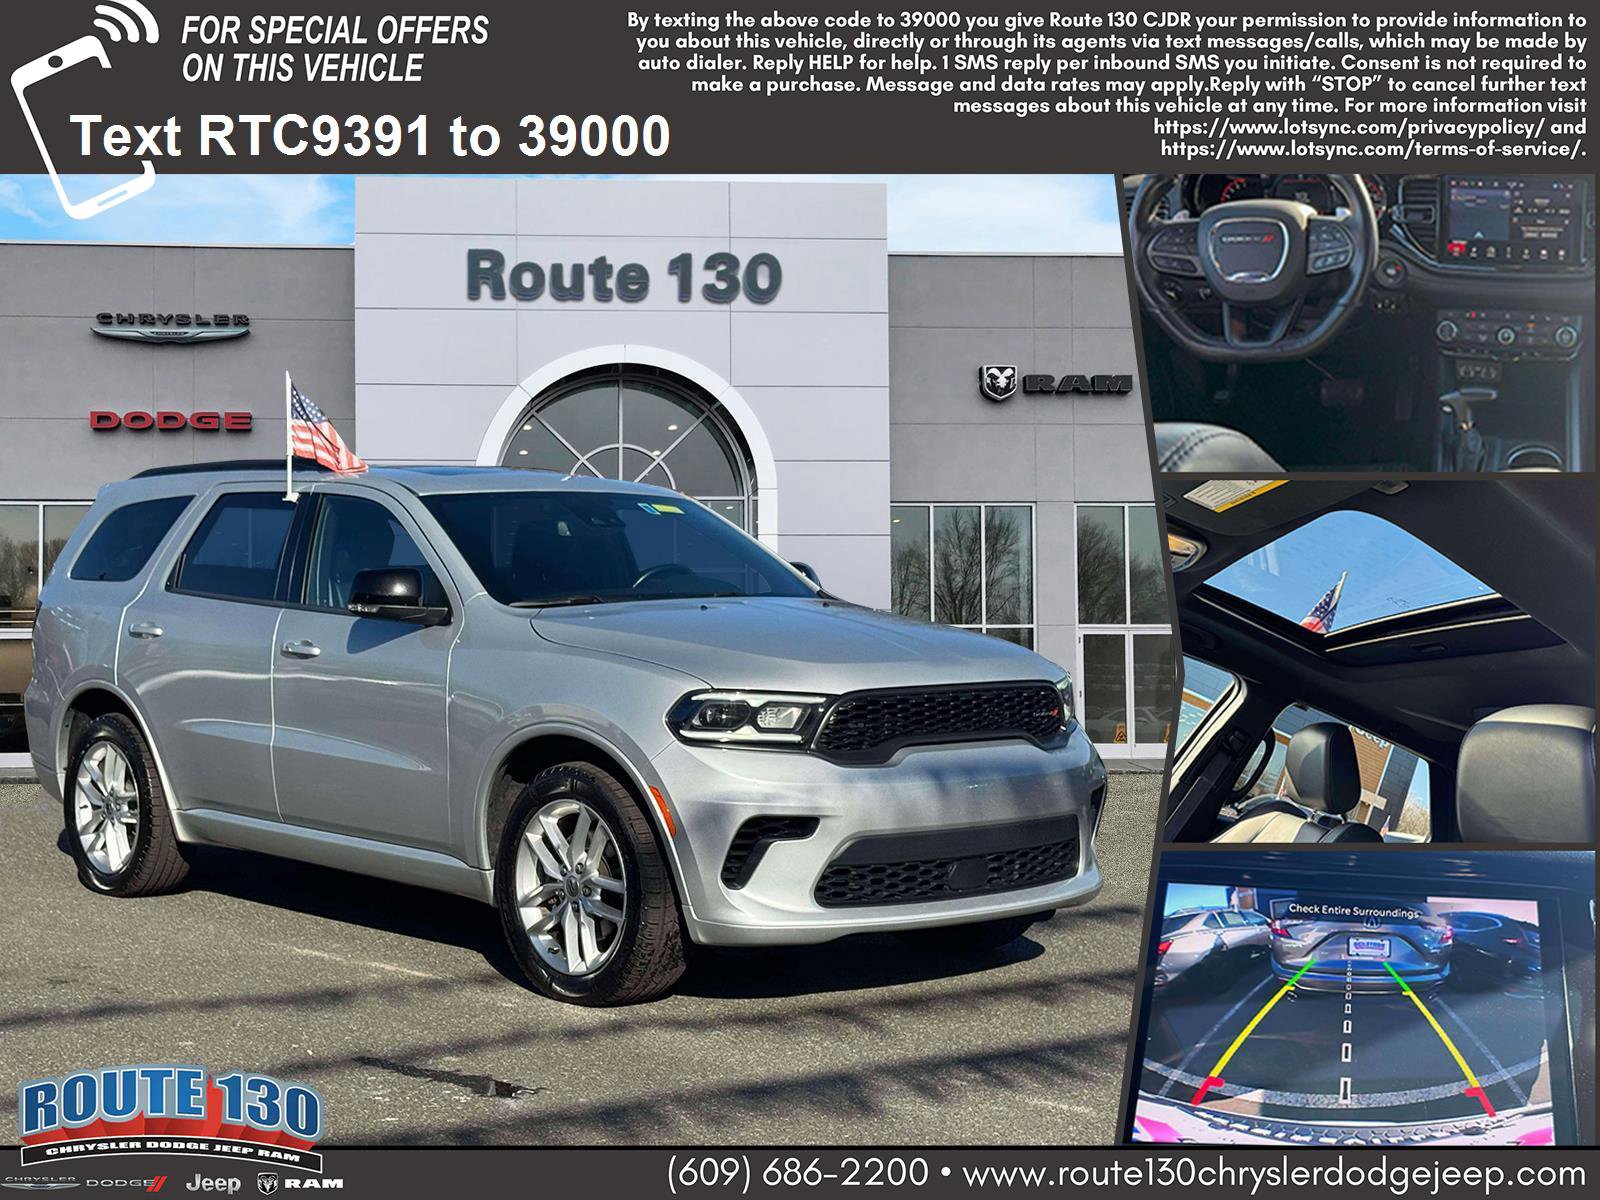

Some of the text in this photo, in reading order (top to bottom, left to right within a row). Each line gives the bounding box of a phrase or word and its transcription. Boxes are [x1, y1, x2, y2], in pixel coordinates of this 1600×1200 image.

[467, 249, 783, 305] Route 130
[96, 312, 250, 326] CHRYSLER
[1023, 374, 1133, 394] RAM
[90, 410, 252, 431] DODGE
[1288, 903, 1419, 919] Check Entire Surroundings
